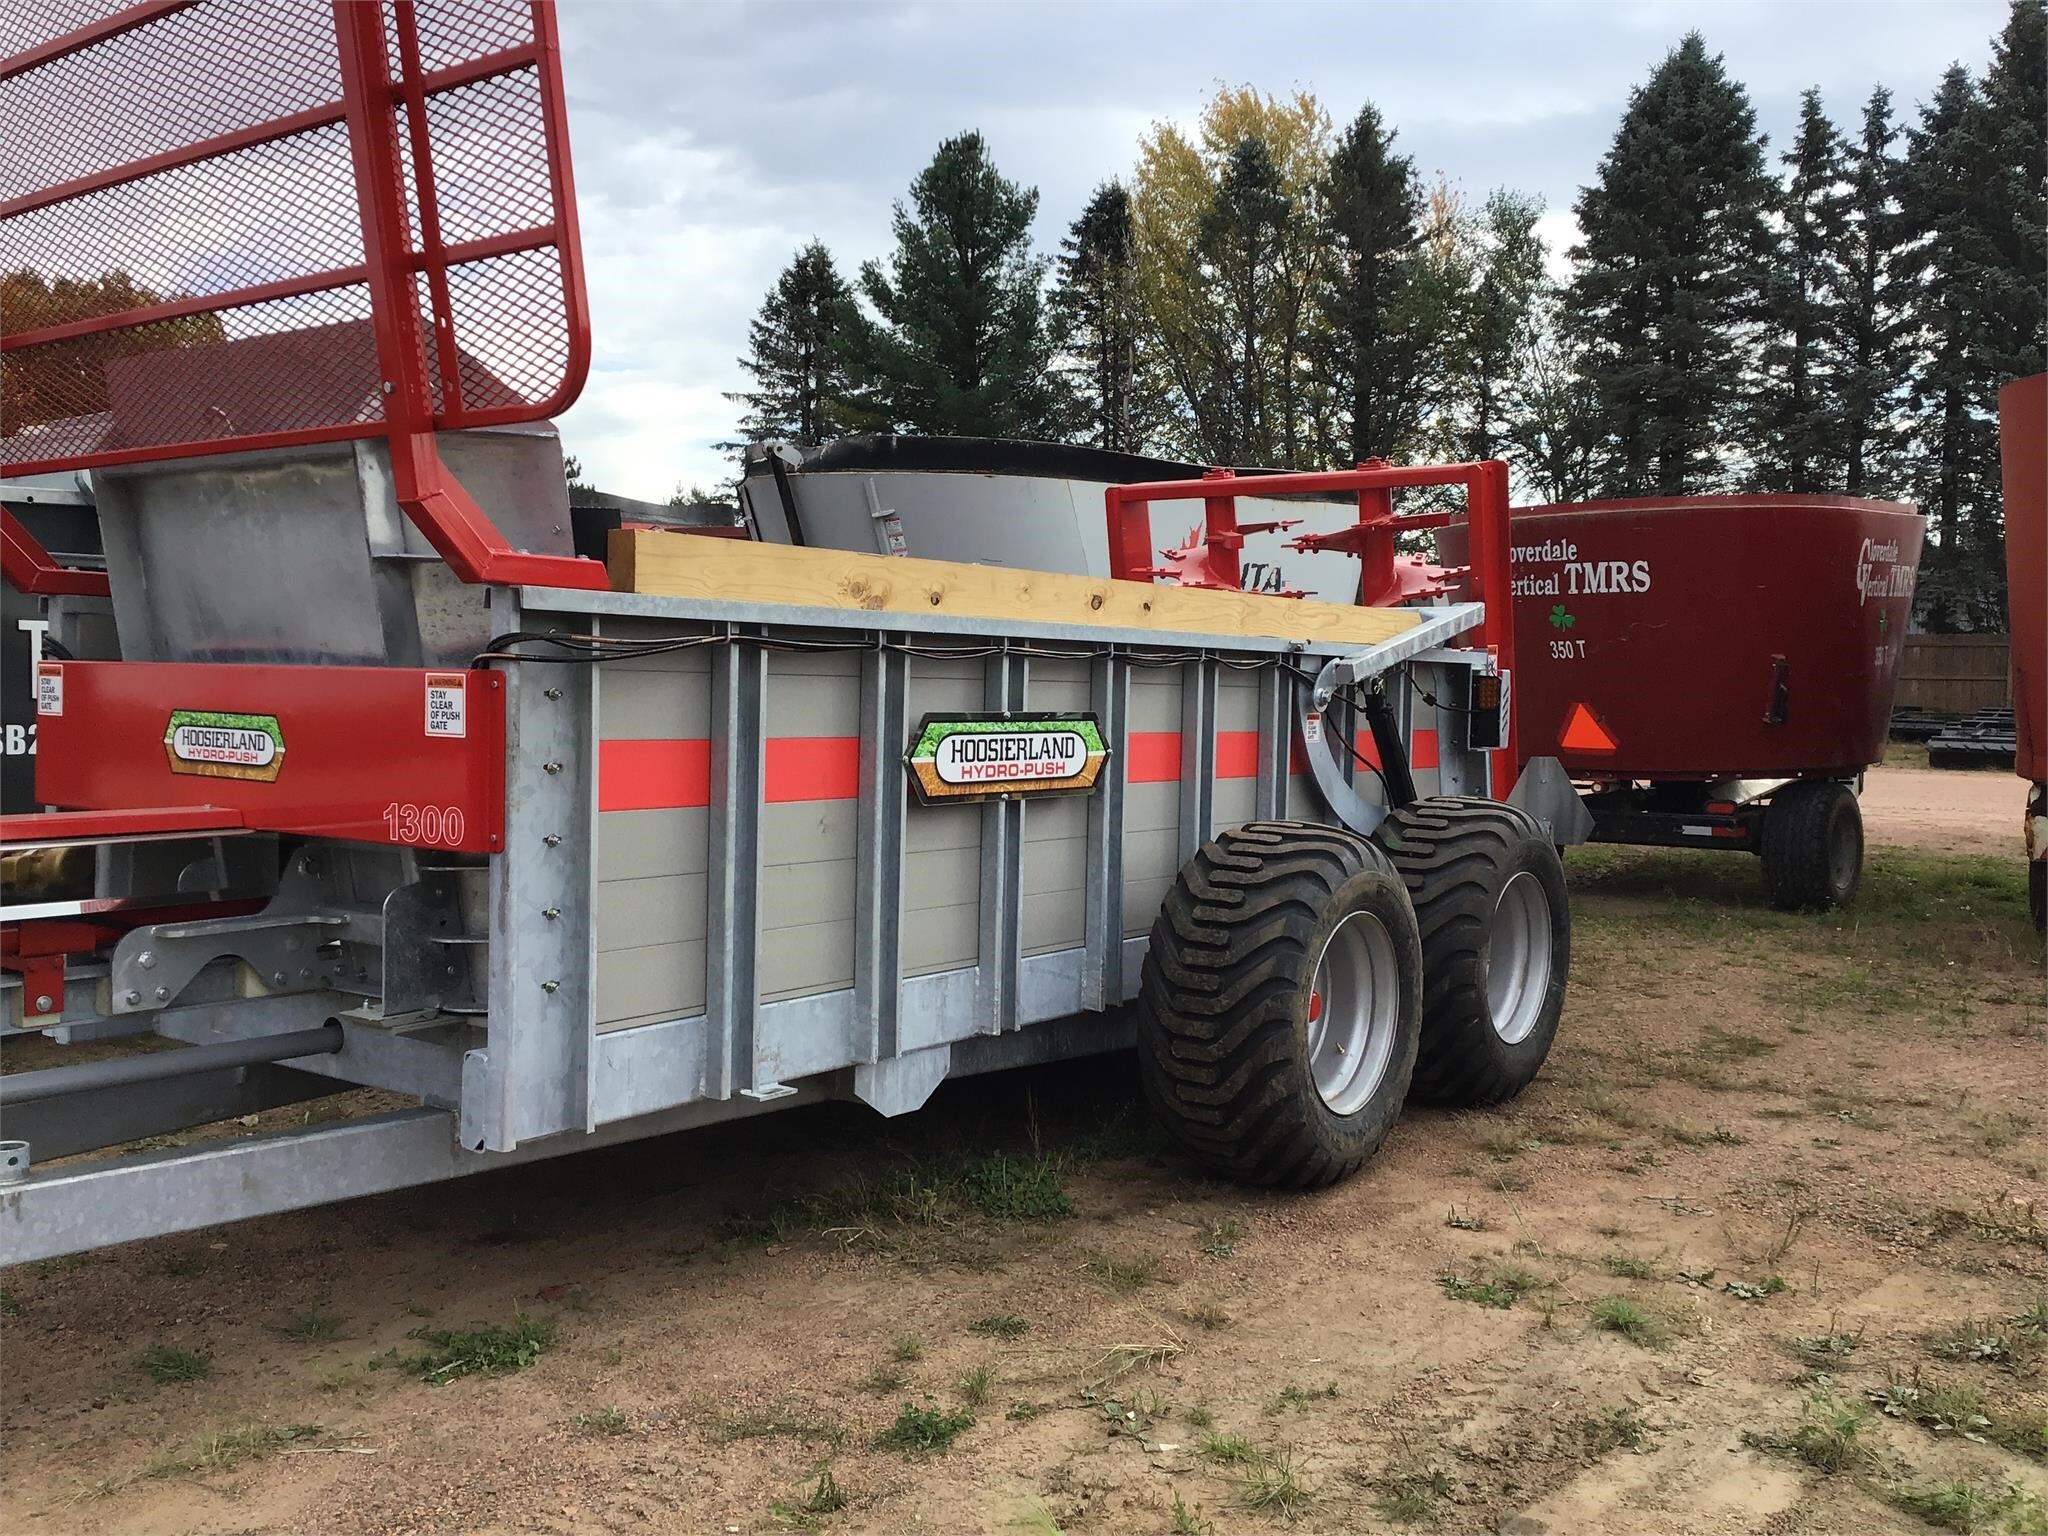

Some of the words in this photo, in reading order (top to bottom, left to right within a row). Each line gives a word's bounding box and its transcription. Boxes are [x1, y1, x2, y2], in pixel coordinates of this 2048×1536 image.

[1563, 560, 1651, 595] TMRS
[1549, 640, 1574, 659] 350
[1575, 640, 1586, 659] T
[41, 686, 56, 694] CLEAR
[430, 690, 447, 700] STAY
[48, 694, 60, 702] PUSH
[41, 702, 52, 710] GATE
[430, 700, 453, 710] CLEAR
[430, 710, 440, 720] OF
[441, 711, 461, 721] PUSH
[430, 720, 448, 730] GATE
[182, 729, 266, 752] HOOSIERLAND
[188, 748, 259, 762] HYDRO-PUSH
[951, 736, 1076, 764] HOOSIERLAND
[961, 761, 1066, 780] HYDRO-PUSH
[383, 802, 465, 847] 1300
